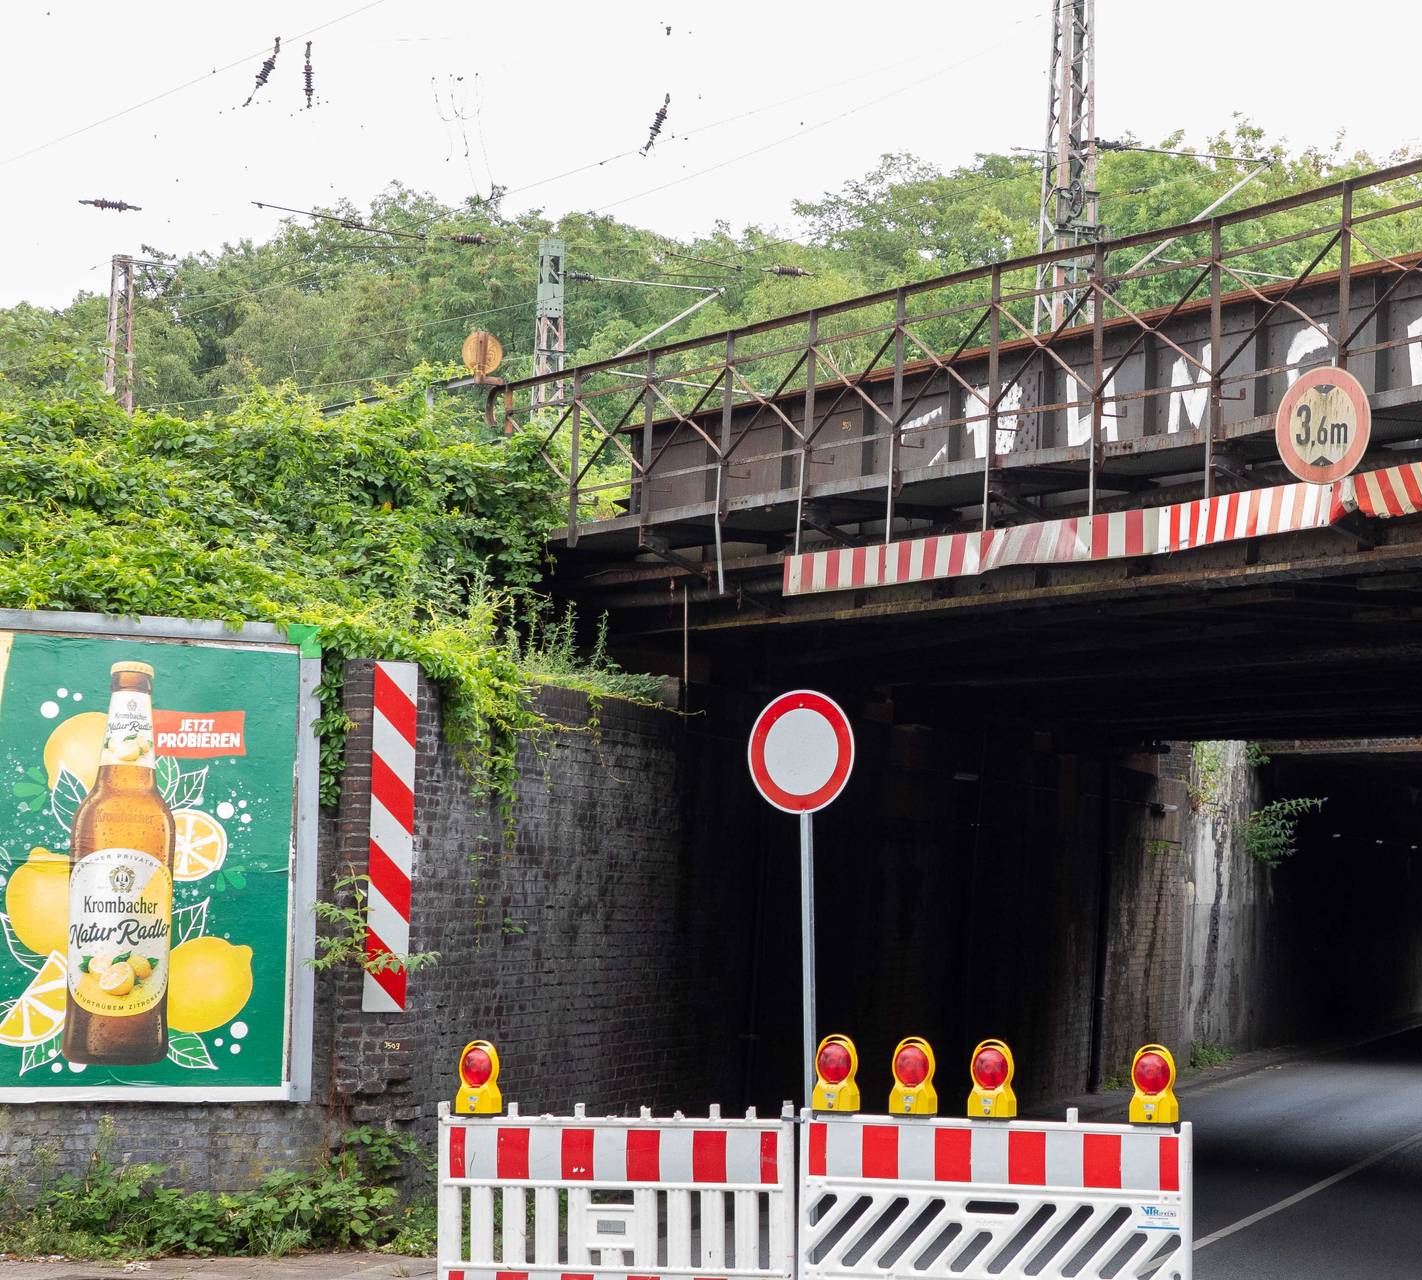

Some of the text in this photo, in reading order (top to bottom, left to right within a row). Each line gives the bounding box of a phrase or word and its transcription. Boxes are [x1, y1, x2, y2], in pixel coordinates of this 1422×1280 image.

[178, 719, 215, 732] JETZT
[157, 732, 241, 749] PROBIEREN
[83, 895, 158, 914] Krombacher
